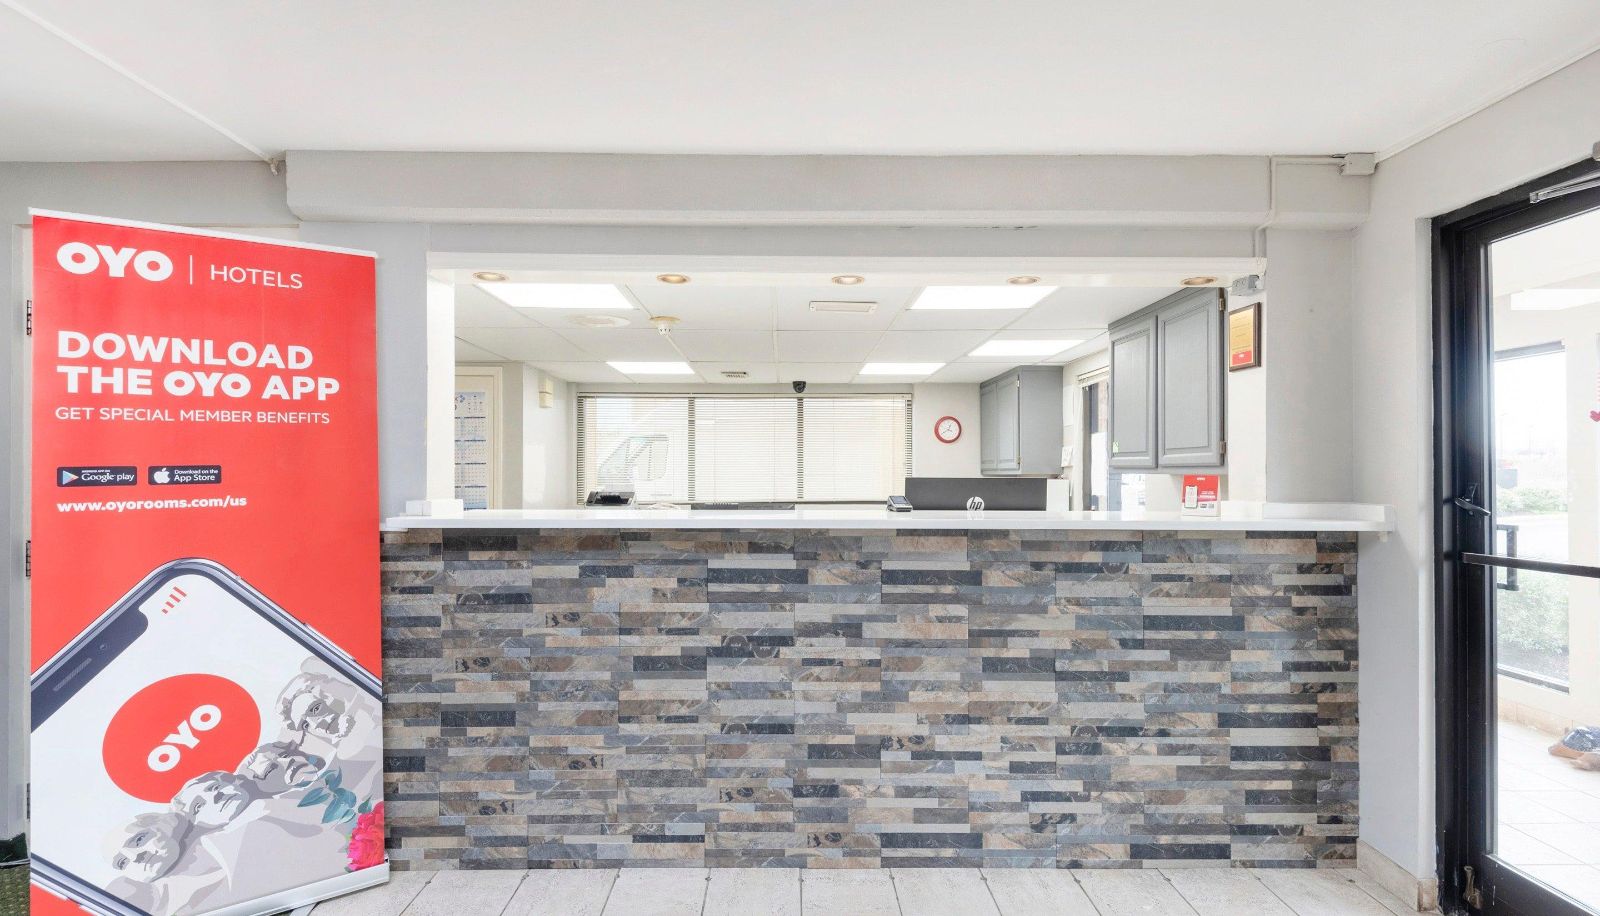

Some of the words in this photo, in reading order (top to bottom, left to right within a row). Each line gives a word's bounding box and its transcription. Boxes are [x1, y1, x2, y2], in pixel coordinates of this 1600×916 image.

[57, 242, 173, 281] OYO
[210, 264, 303, 289] HOTELS
[57, 331, 313, 369] DOWNLOAD
[57, 366, 152, 395] THE
[163, 371, 251, 397] OYO
[261, 375, 340, 401] APP
[55, 407, 94, 420] GET
[100, 408, 175, 421] SPECIAL
[180, 410, 252, 422] MEMBER
[257, 411, 330, 424] BENEFITS
[81, 473, 115, 482] Google
[117, 472, 135, 482] play
[174, 474, 192, 483] App
[57, 495, 247, 512] www.oyorooms.com/us
[147, 704, 222, 772] OYO
